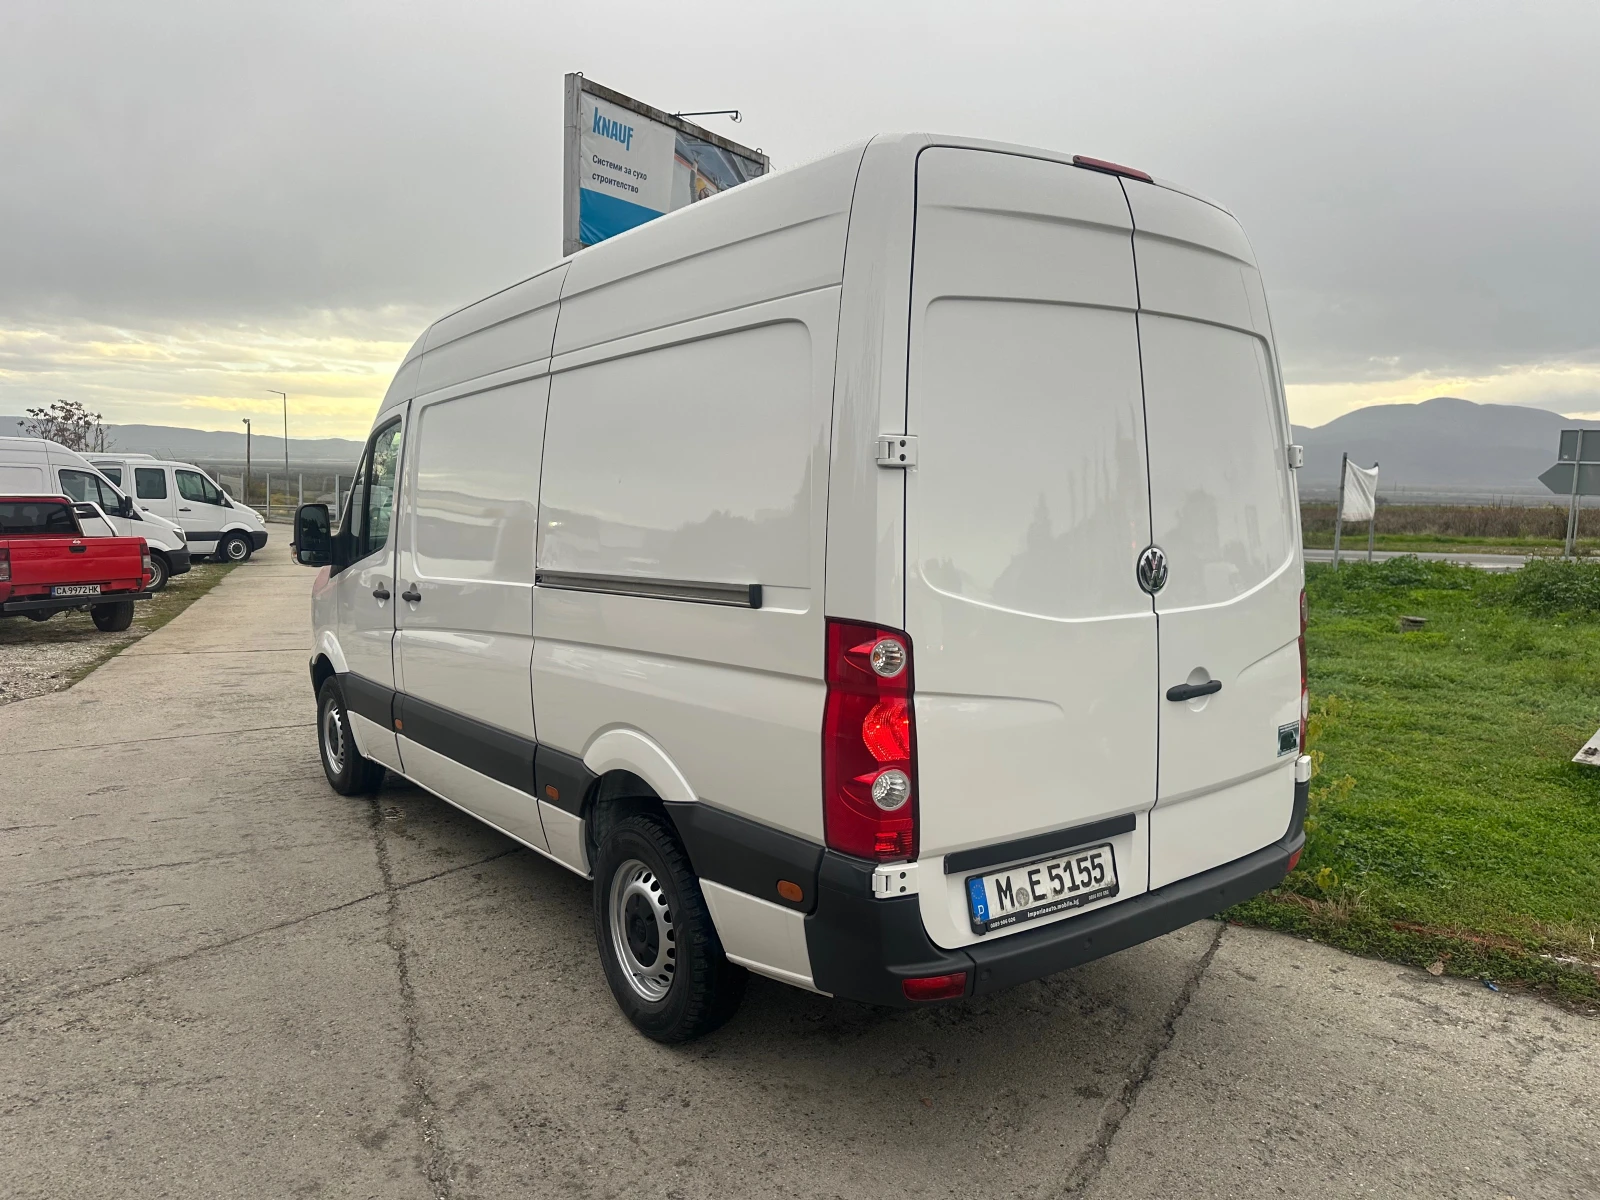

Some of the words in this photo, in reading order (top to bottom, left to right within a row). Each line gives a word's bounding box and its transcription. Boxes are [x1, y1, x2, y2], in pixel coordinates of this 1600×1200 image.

[592, 154, 623, 173] Системи
[624, 167, 633, 176] за
[633, 170, 648, 181] сухо
[592, 172, 639, 194] строителство
[995, 875, 1015, 912] M
[977, 904, 985, 915] D
